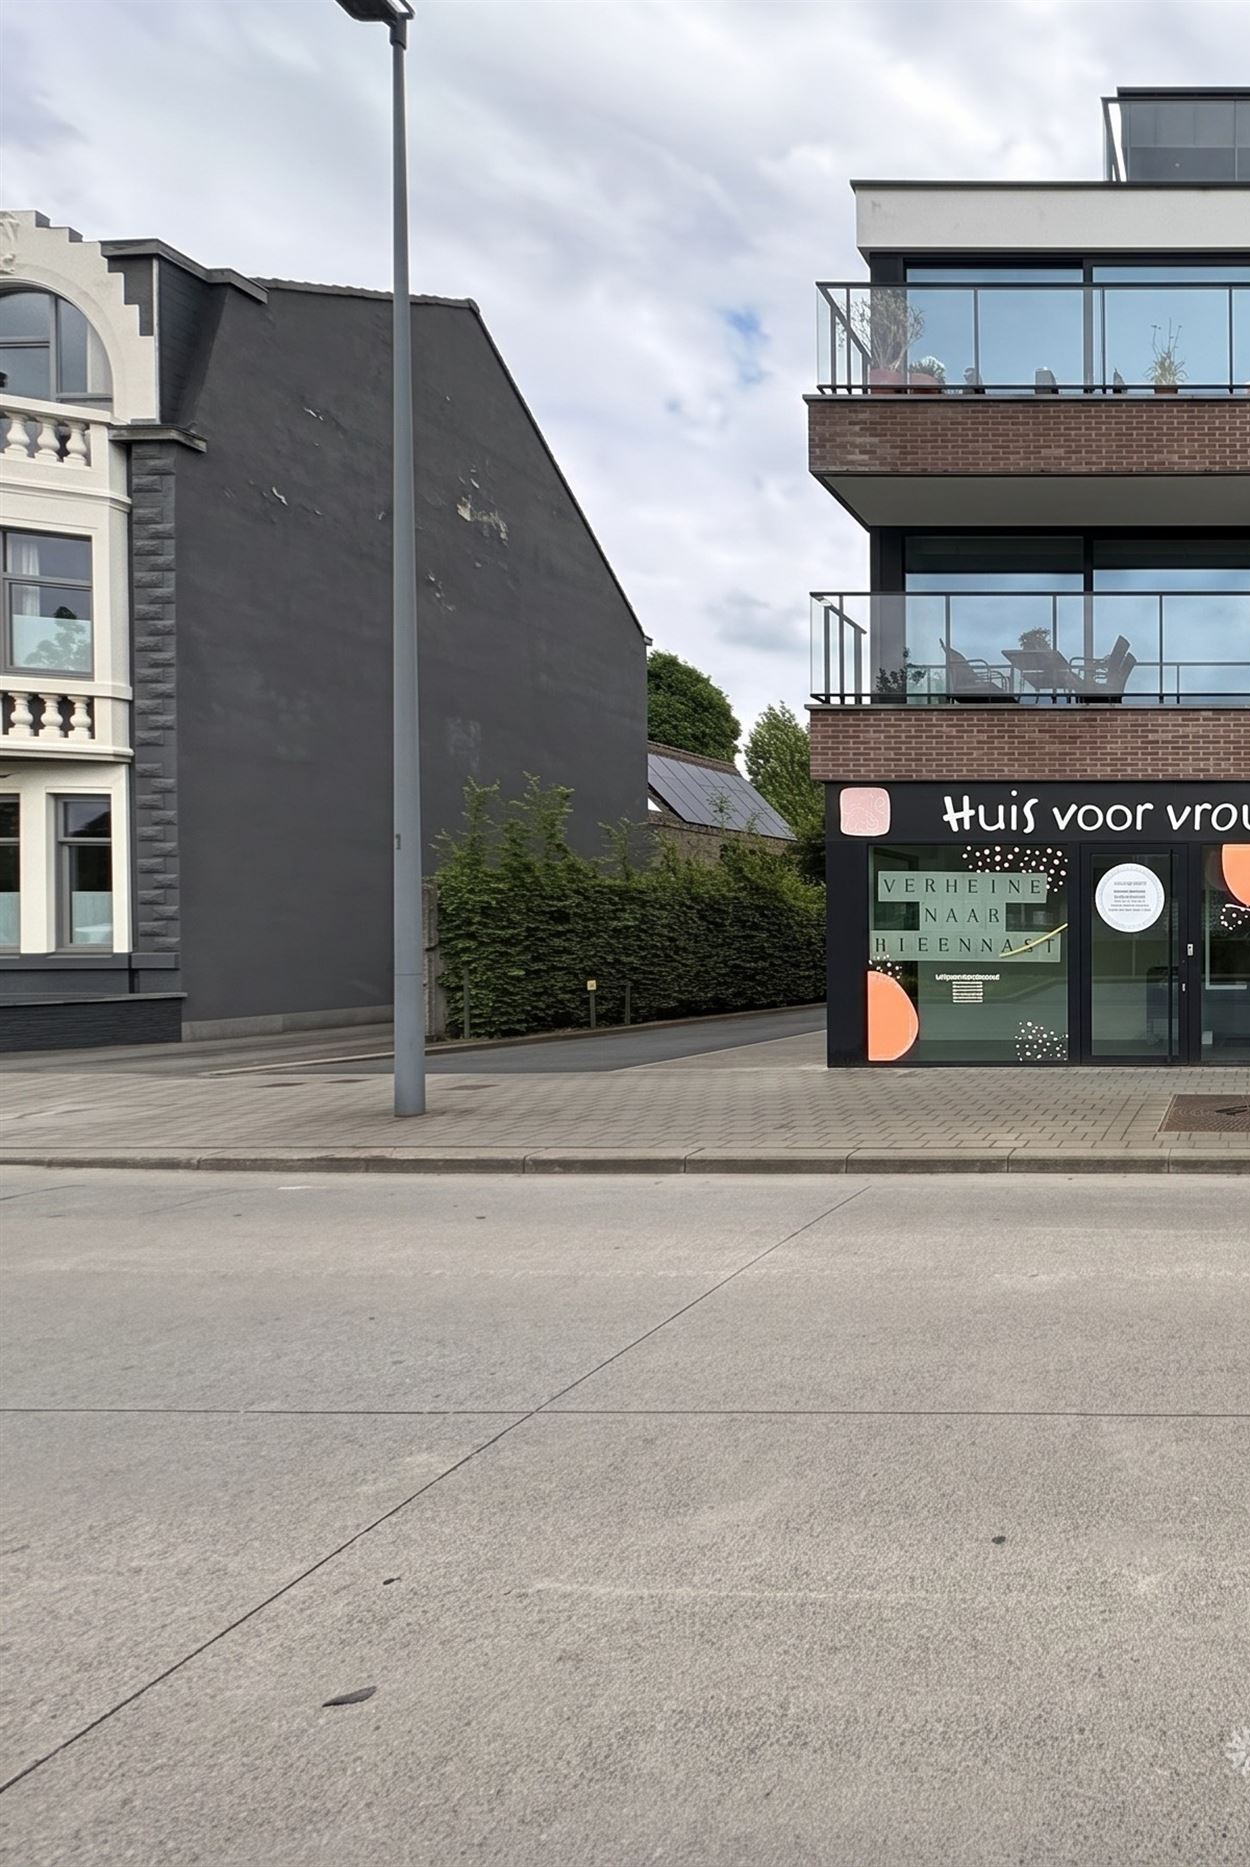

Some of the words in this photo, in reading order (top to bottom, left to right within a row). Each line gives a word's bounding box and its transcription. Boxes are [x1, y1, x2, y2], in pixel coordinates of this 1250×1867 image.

[942, 789, 1039, 834] Huis
[1052, 803, 1154, 831] voor
[883, 878, 1041, 894] VERHEINE
[924, 907, 1000, 923] NAAR
